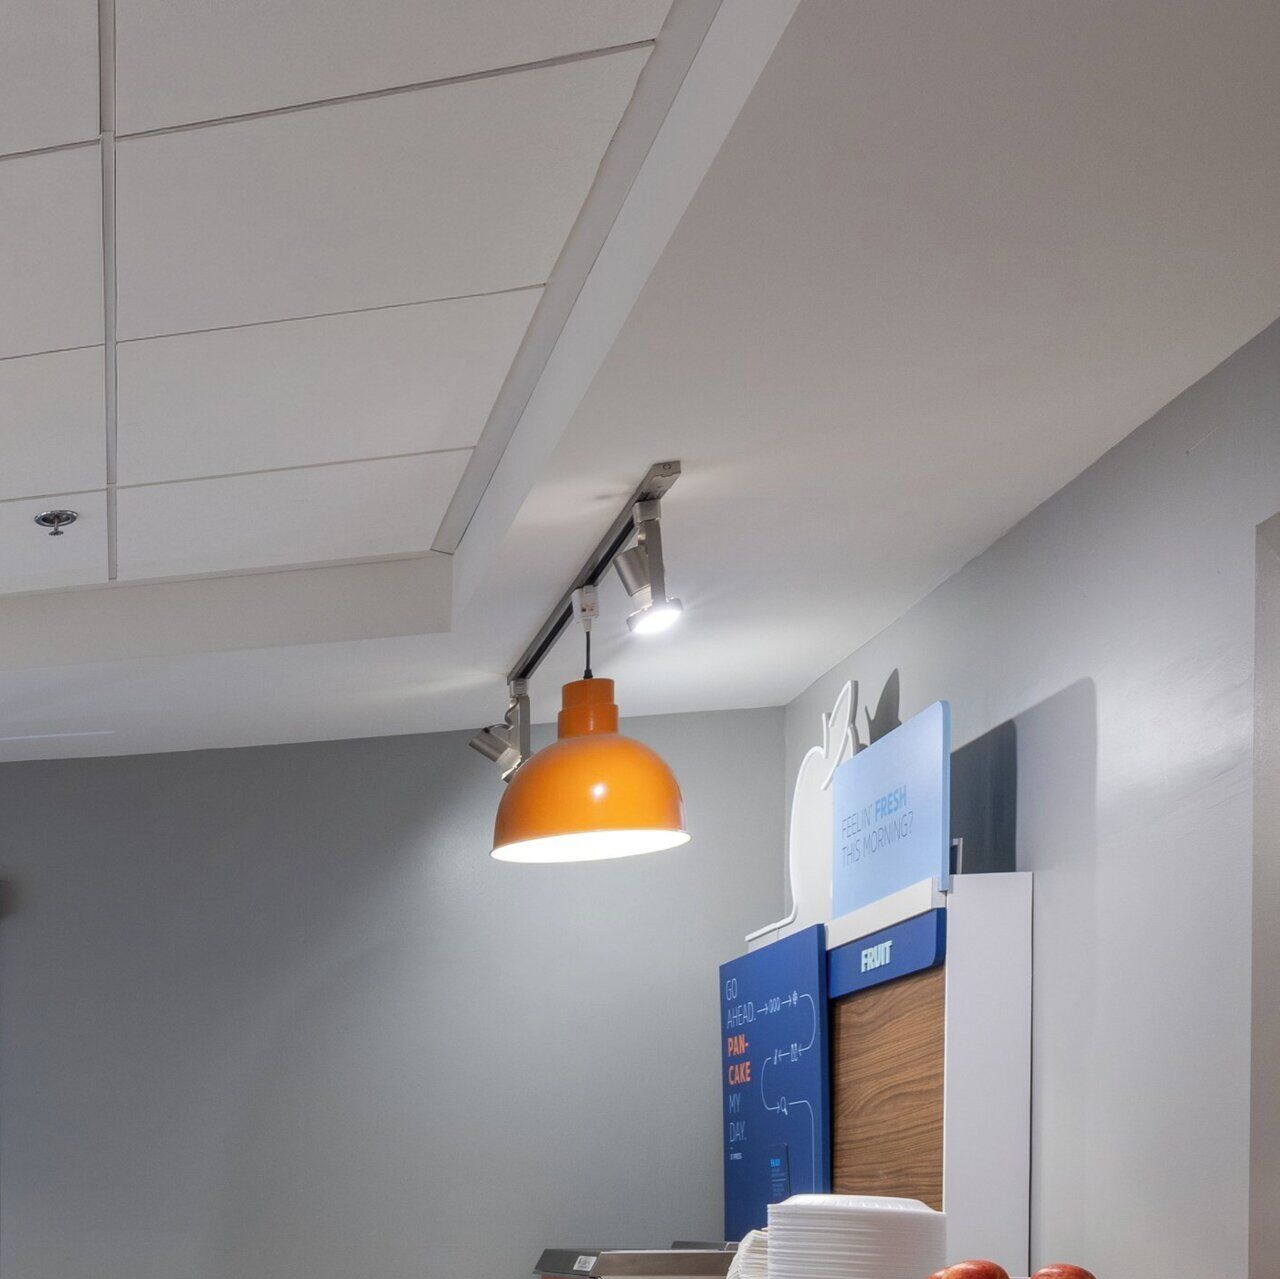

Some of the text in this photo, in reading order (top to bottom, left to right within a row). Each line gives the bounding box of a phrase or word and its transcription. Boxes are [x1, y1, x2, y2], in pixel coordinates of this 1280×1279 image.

[875, 785, 907, 820] FRESH
[842, 811, 914, 868] THIS MORNING?
[861, 940, 893, 973] FRUIT
[726, 978, 737, 1001] GO
[727, 1002, 756, 1029] AHEAD.
[727, 1034, 749, 1057] PAN-
[728, 1061, 751, 1085] CAKE
[729, 1093, 740, 1114] MY
[730, 1121, 747, 1142] DAY.
